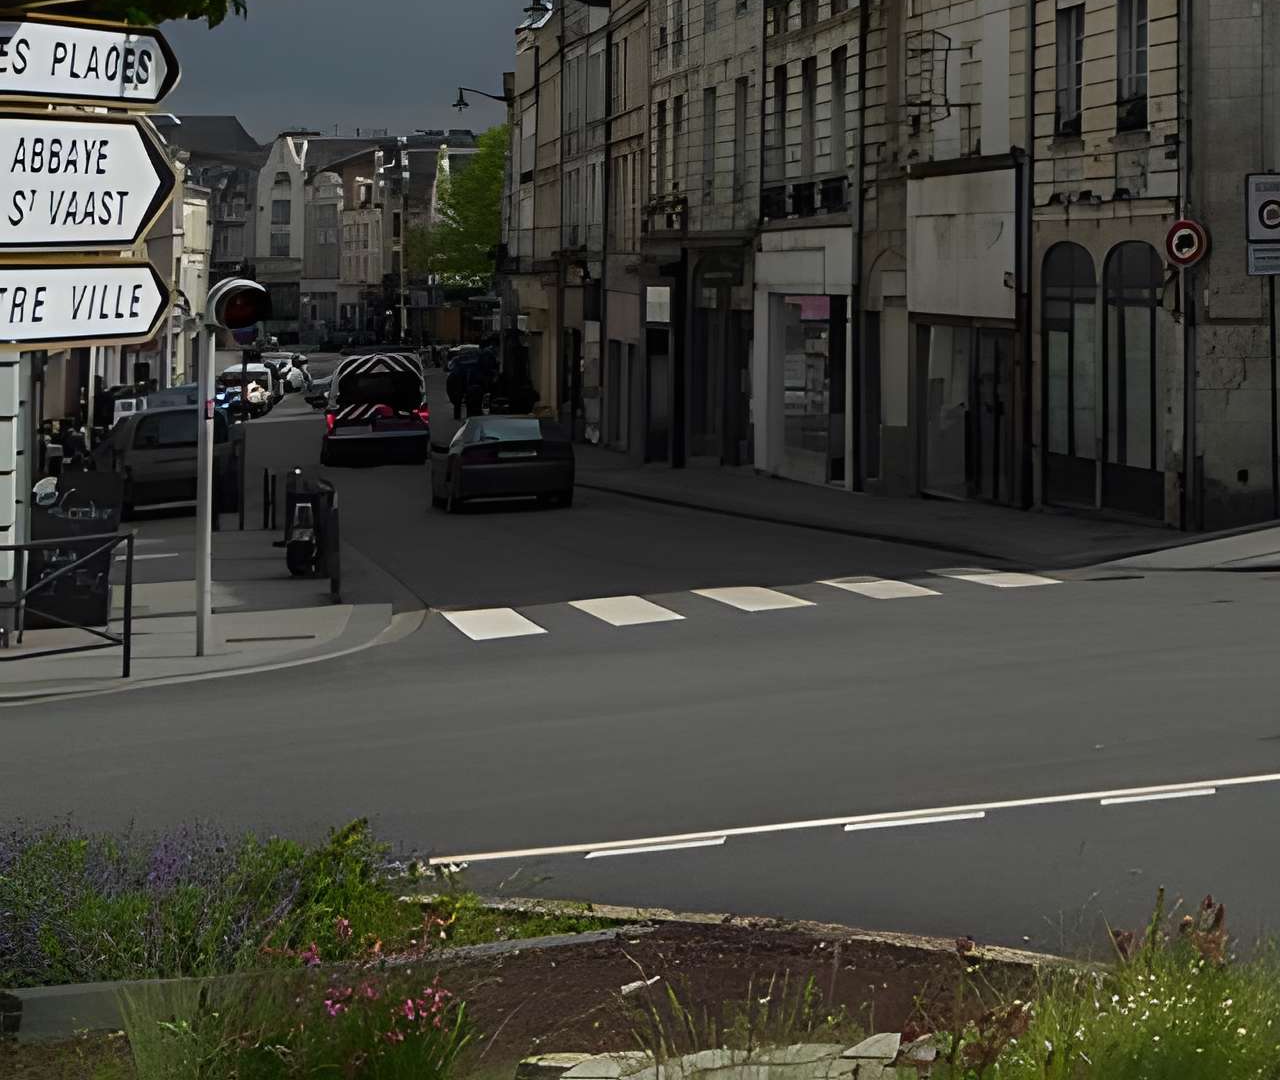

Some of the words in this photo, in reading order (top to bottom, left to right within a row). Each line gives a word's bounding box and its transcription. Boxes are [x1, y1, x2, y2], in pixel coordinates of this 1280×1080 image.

[11, 137, 109, 174] ABBAYE
[49, 190, 129, 226] VAAST
[71, 284, 143, 321] VILLE
